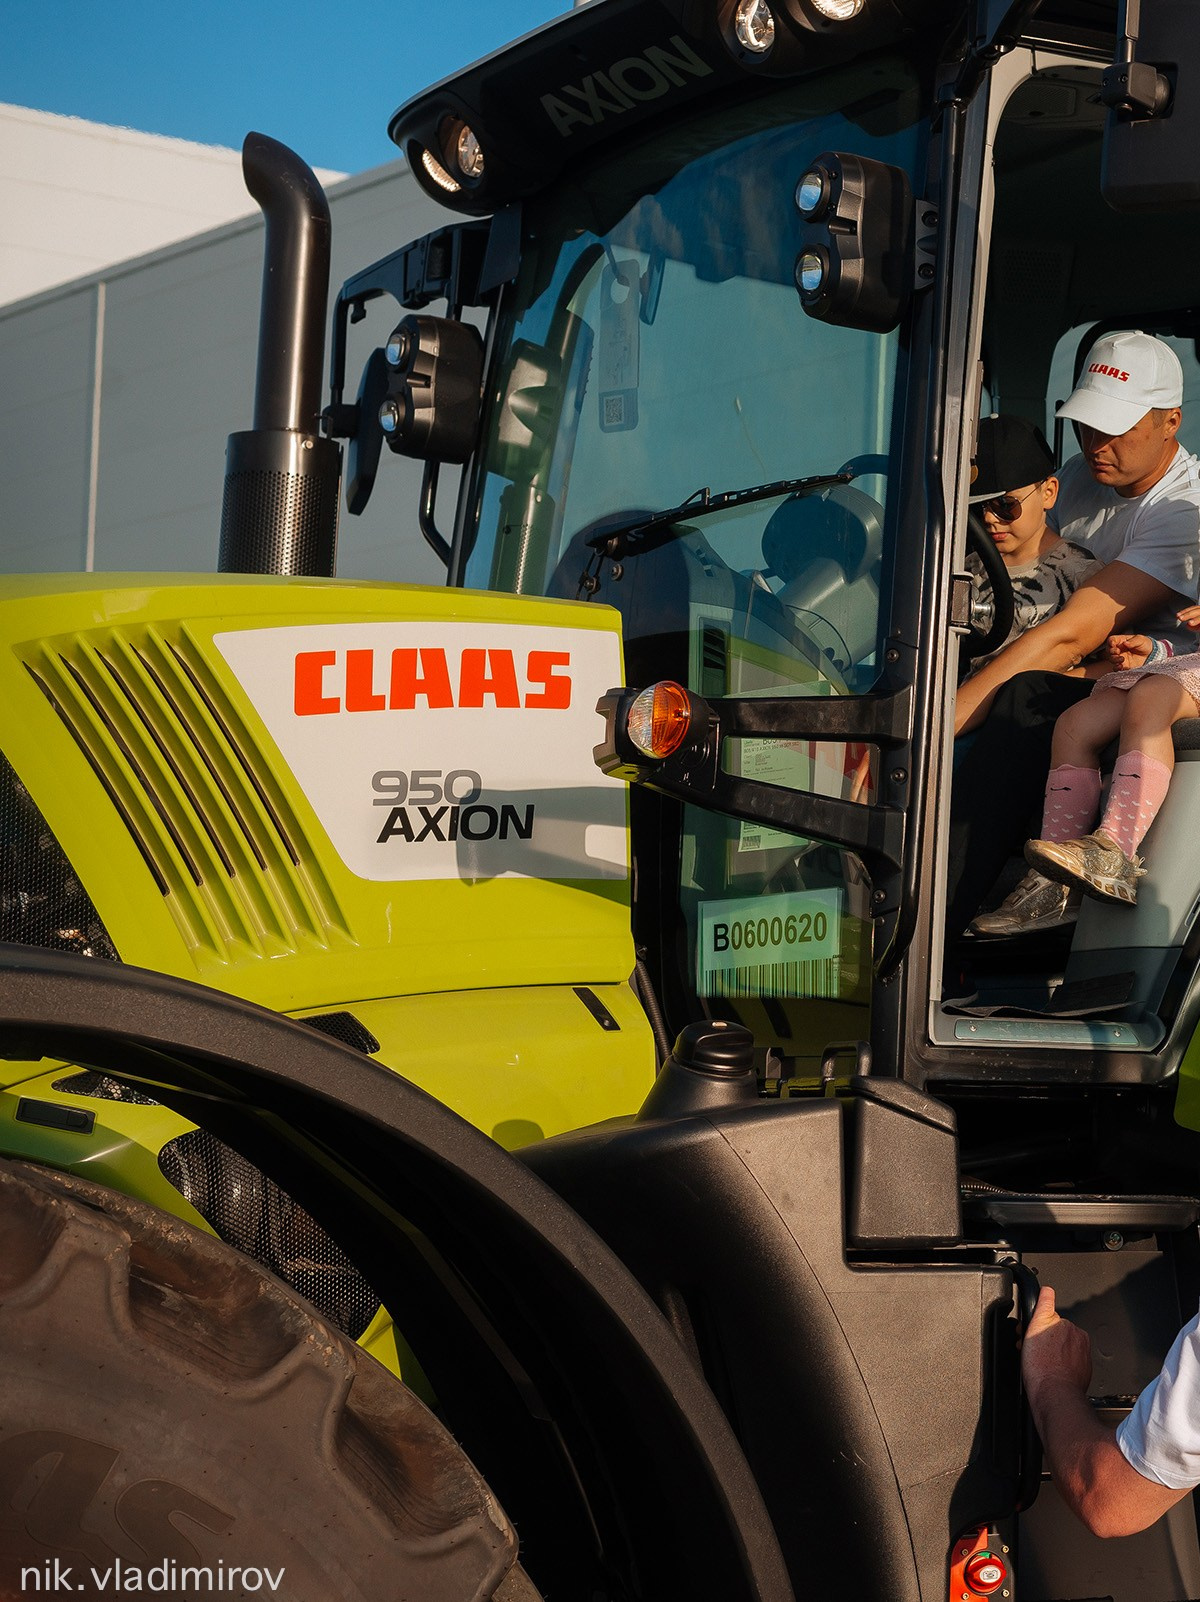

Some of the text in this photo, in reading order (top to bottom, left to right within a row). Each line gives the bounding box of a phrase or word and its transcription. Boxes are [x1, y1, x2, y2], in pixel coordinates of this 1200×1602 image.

[539, 35, 714, 138] AXION
[1088, 363, 1131, 383] CLAAS
[294, 648, 572, 716] CLAAS
[372, 769, 482, 806] 950
[377, 800, 534, 844] AXION
[714, 912, 828, 952] B0600620
